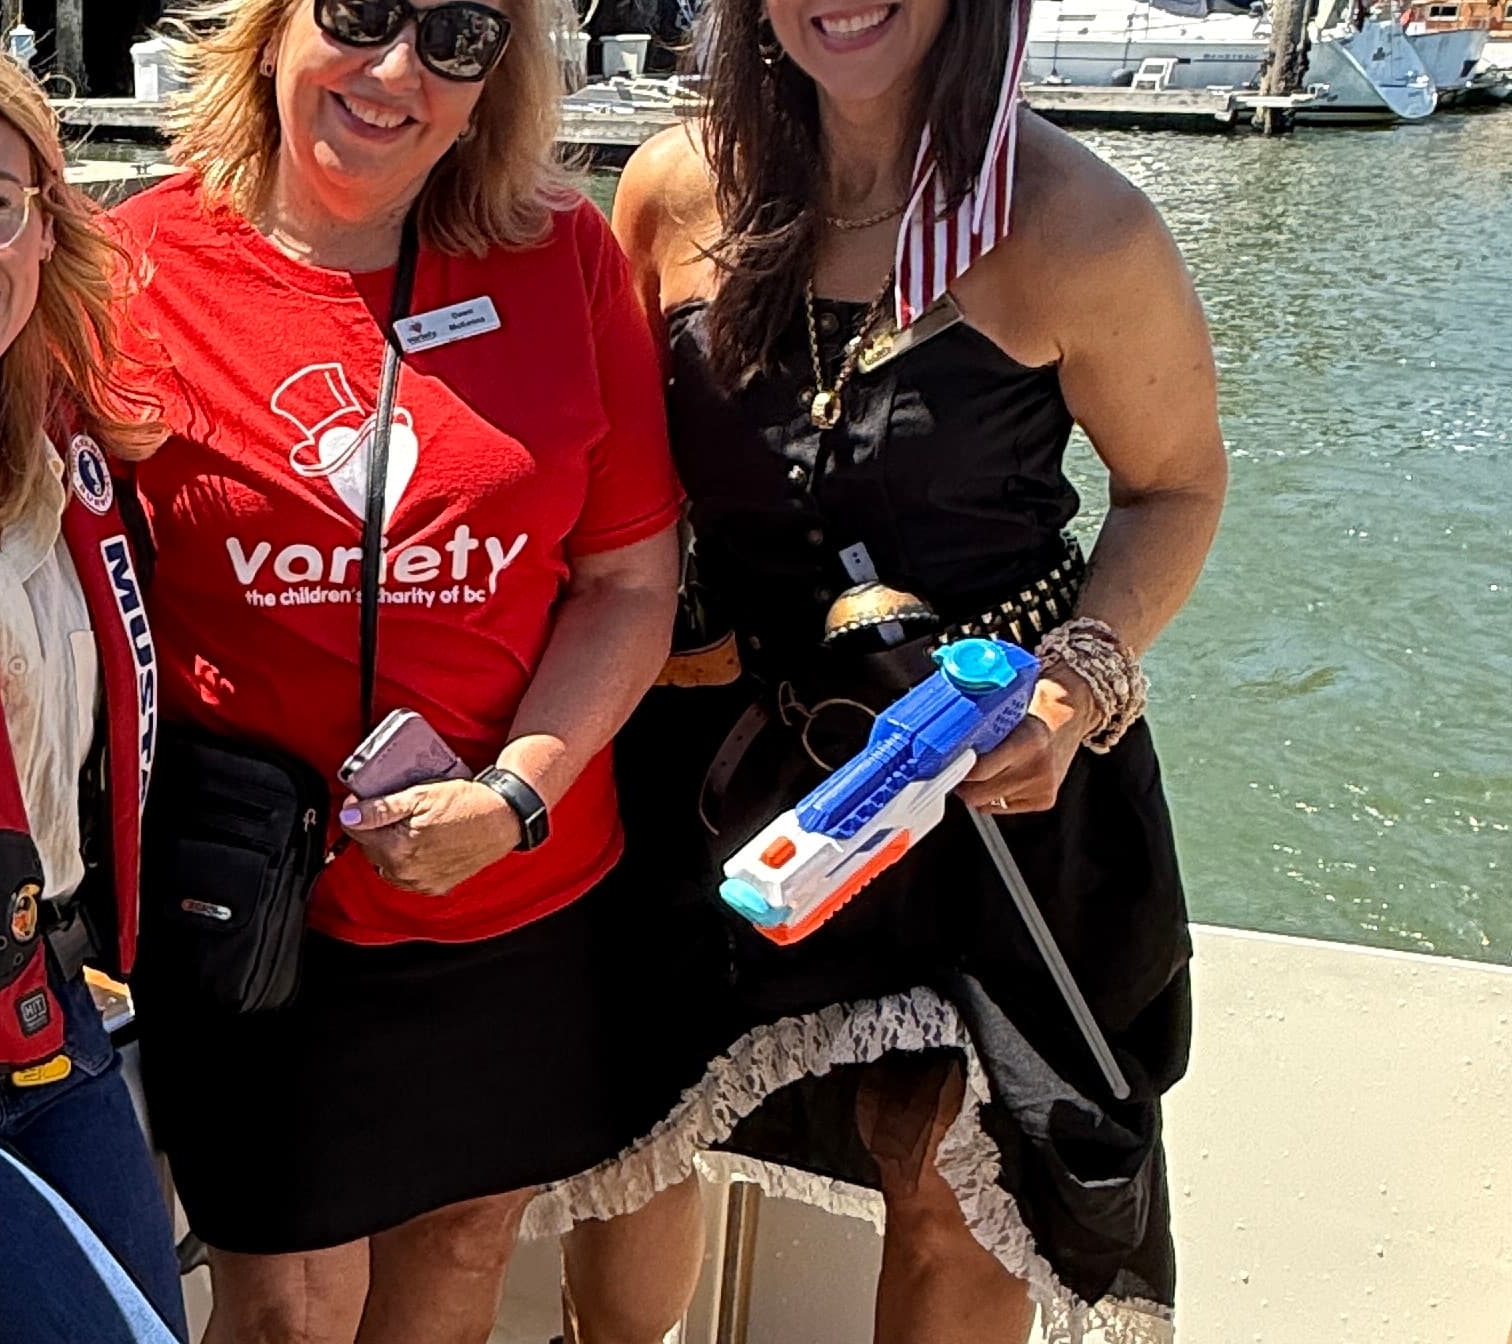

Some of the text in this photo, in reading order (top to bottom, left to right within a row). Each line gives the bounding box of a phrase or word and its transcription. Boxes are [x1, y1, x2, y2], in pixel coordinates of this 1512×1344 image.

[226, 524, 529, 595] variety
[245, 588, 276, 607] the
[377, 586, 436, 608] harity
[439, 585, 460, 604] of
[464, 585, 487, 604] bc
